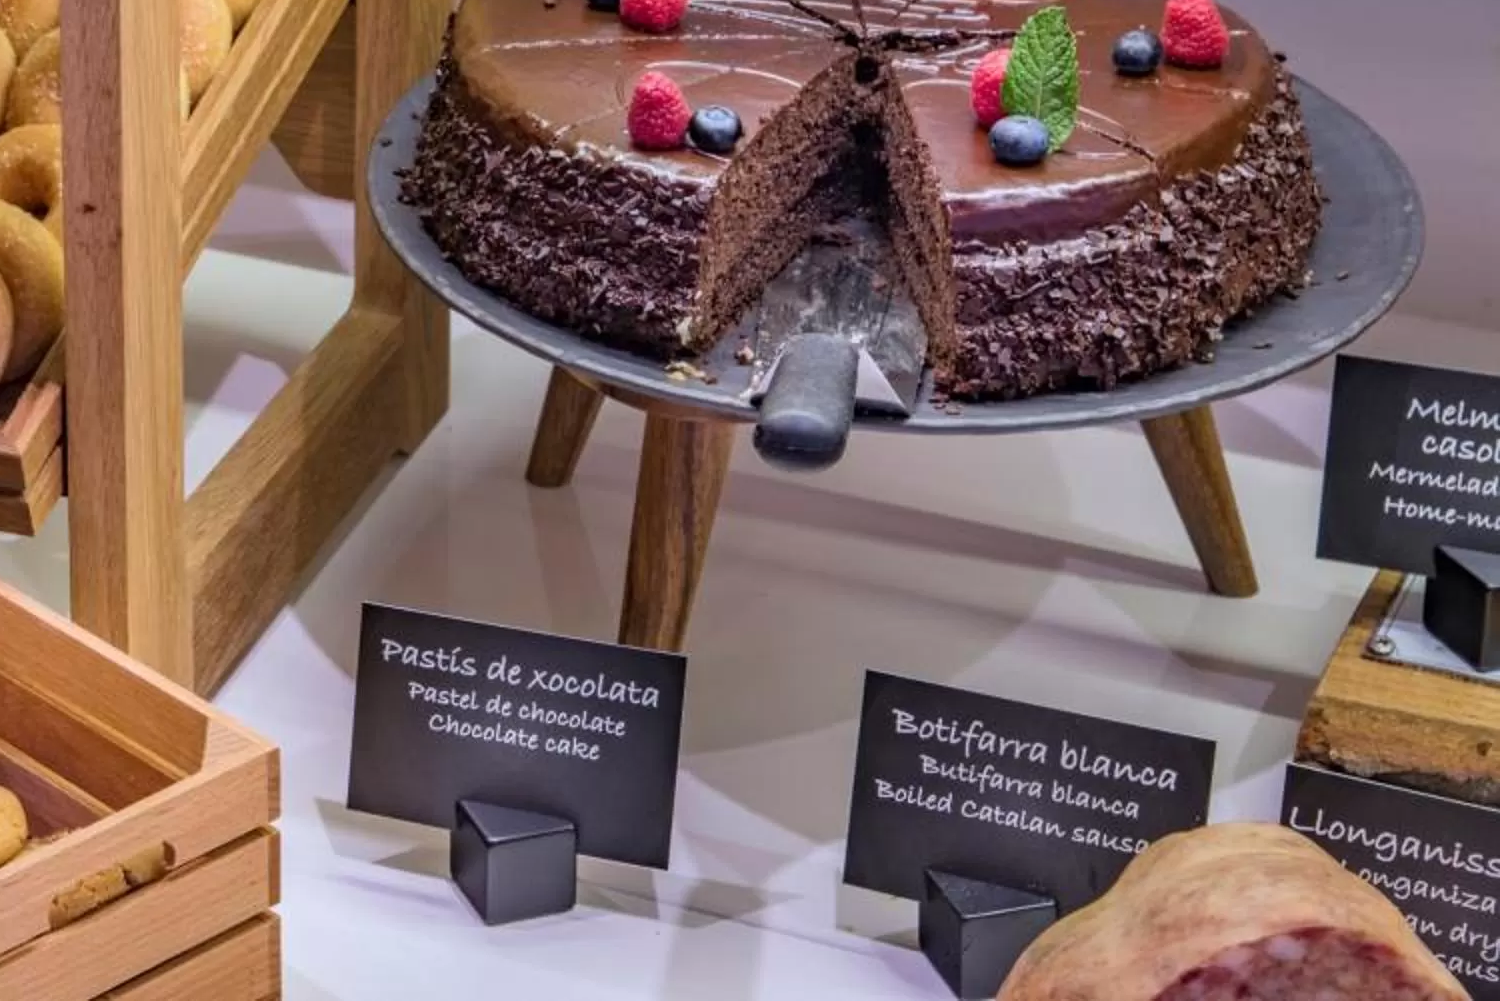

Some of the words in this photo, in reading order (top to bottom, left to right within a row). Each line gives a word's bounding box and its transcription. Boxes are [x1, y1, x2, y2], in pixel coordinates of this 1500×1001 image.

[380, 637, 478, 677] Pastís
[487, 655, 521, 686] de
[527, 669, 661, 707] xocolata
[408, 681, 480, 711] Pastel
[485, 694, 513, 716] de
[518, 701, 626, 737] chocolate
[428, 713, 540, 751] Chocolate
[545, 736, 600, 761] cake
[891, 707, 1049, 764] Botifarra
[1058, 739, 1179, 791] blanca
[875, 778, 953, 814] Boiled
[961, 799, 1066, 838] Catalan
[919, 753, 1043, 798] Butifarra
[1051, 780, 1141, 819] blanca
[1340, 858, 1496, 914] onganiza
